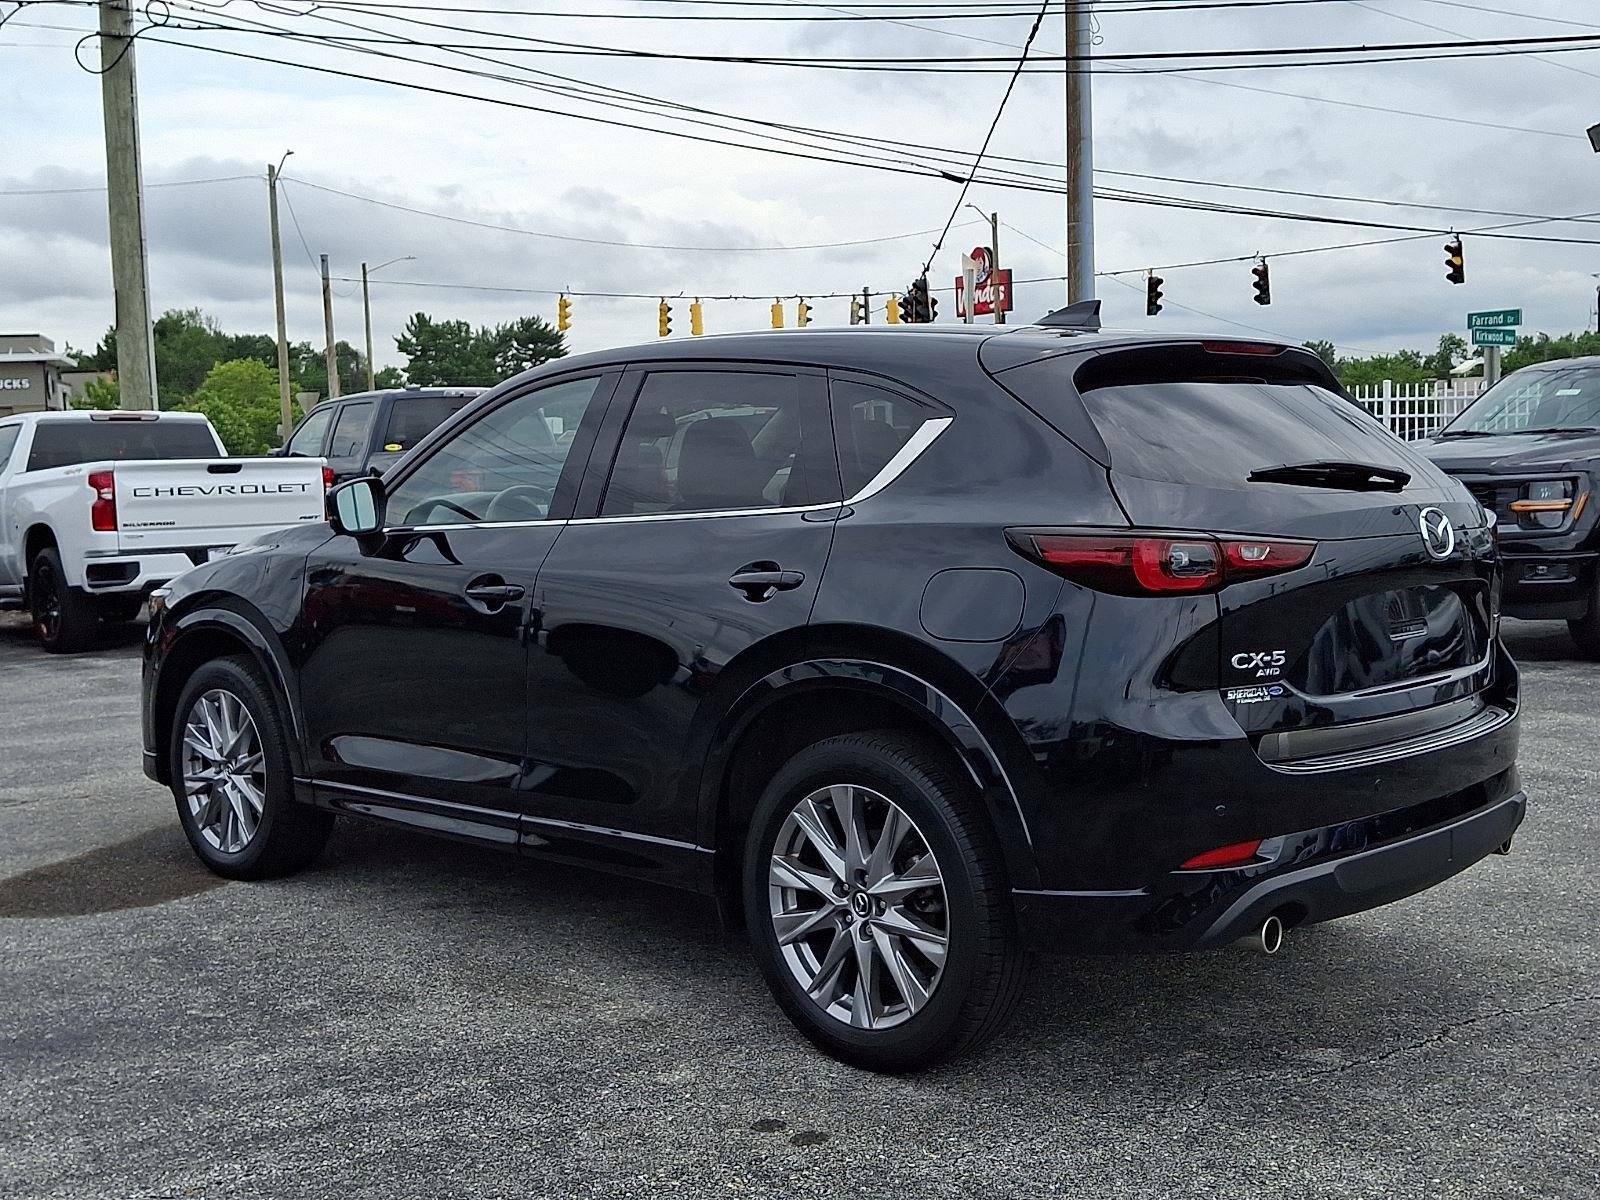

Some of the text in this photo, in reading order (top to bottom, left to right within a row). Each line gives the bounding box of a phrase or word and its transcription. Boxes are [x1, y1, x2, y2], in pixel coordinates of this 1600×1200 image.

[1472, 313, 1514, 326] Farrand Dr
[1476, 330, 1503, 342] Kirkwood
[133, 483, 311, 497] CHEVROLET
[1231, 650, 1286, 669] CX-5
[1255, 667, 1280, 678] AWD
[1227, 687, 1269, 700] SHERIDAN
